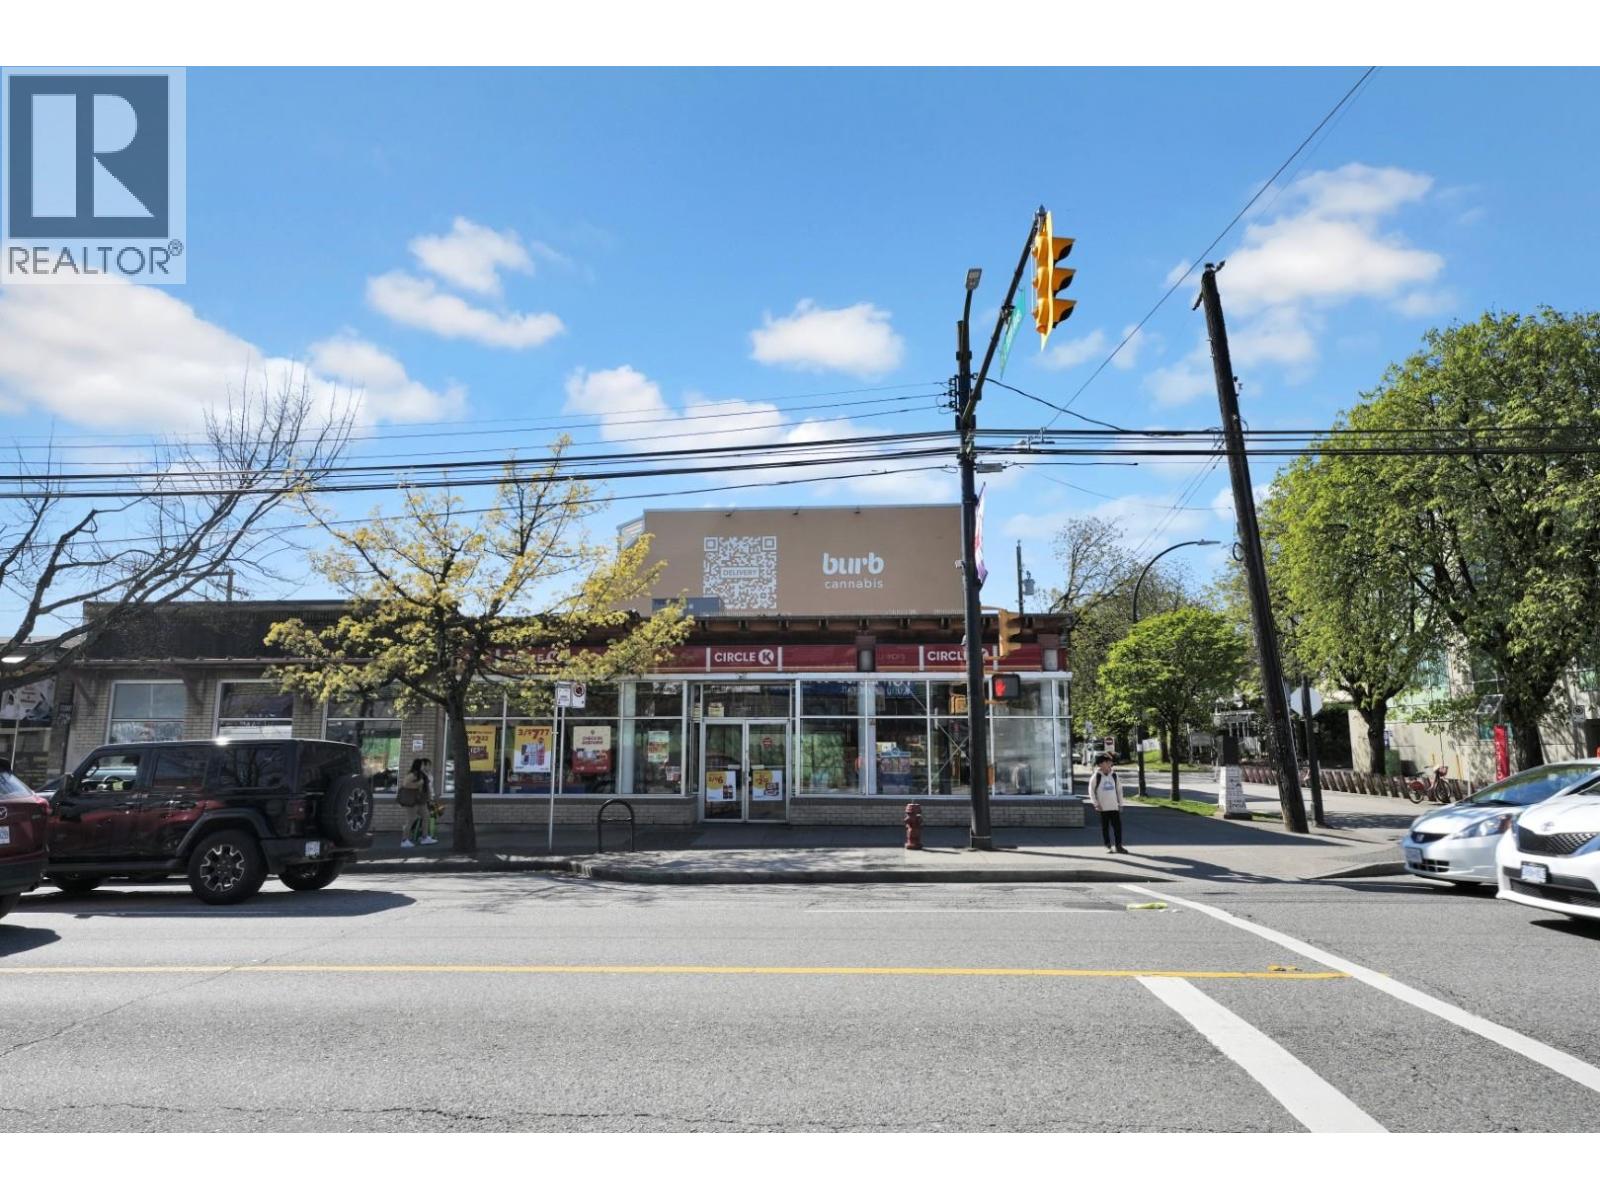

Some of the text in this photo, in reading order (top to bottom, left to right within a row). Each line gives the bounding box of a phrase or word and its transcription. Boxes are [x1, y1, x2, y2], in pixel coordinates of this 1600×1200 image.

[822, 552, 884, 575] burb
[722, 568, 759, 577] DELIVERY
[824, 579, 883, 590] cannabis
[714, 649, 775, 665] CIRCLE K
